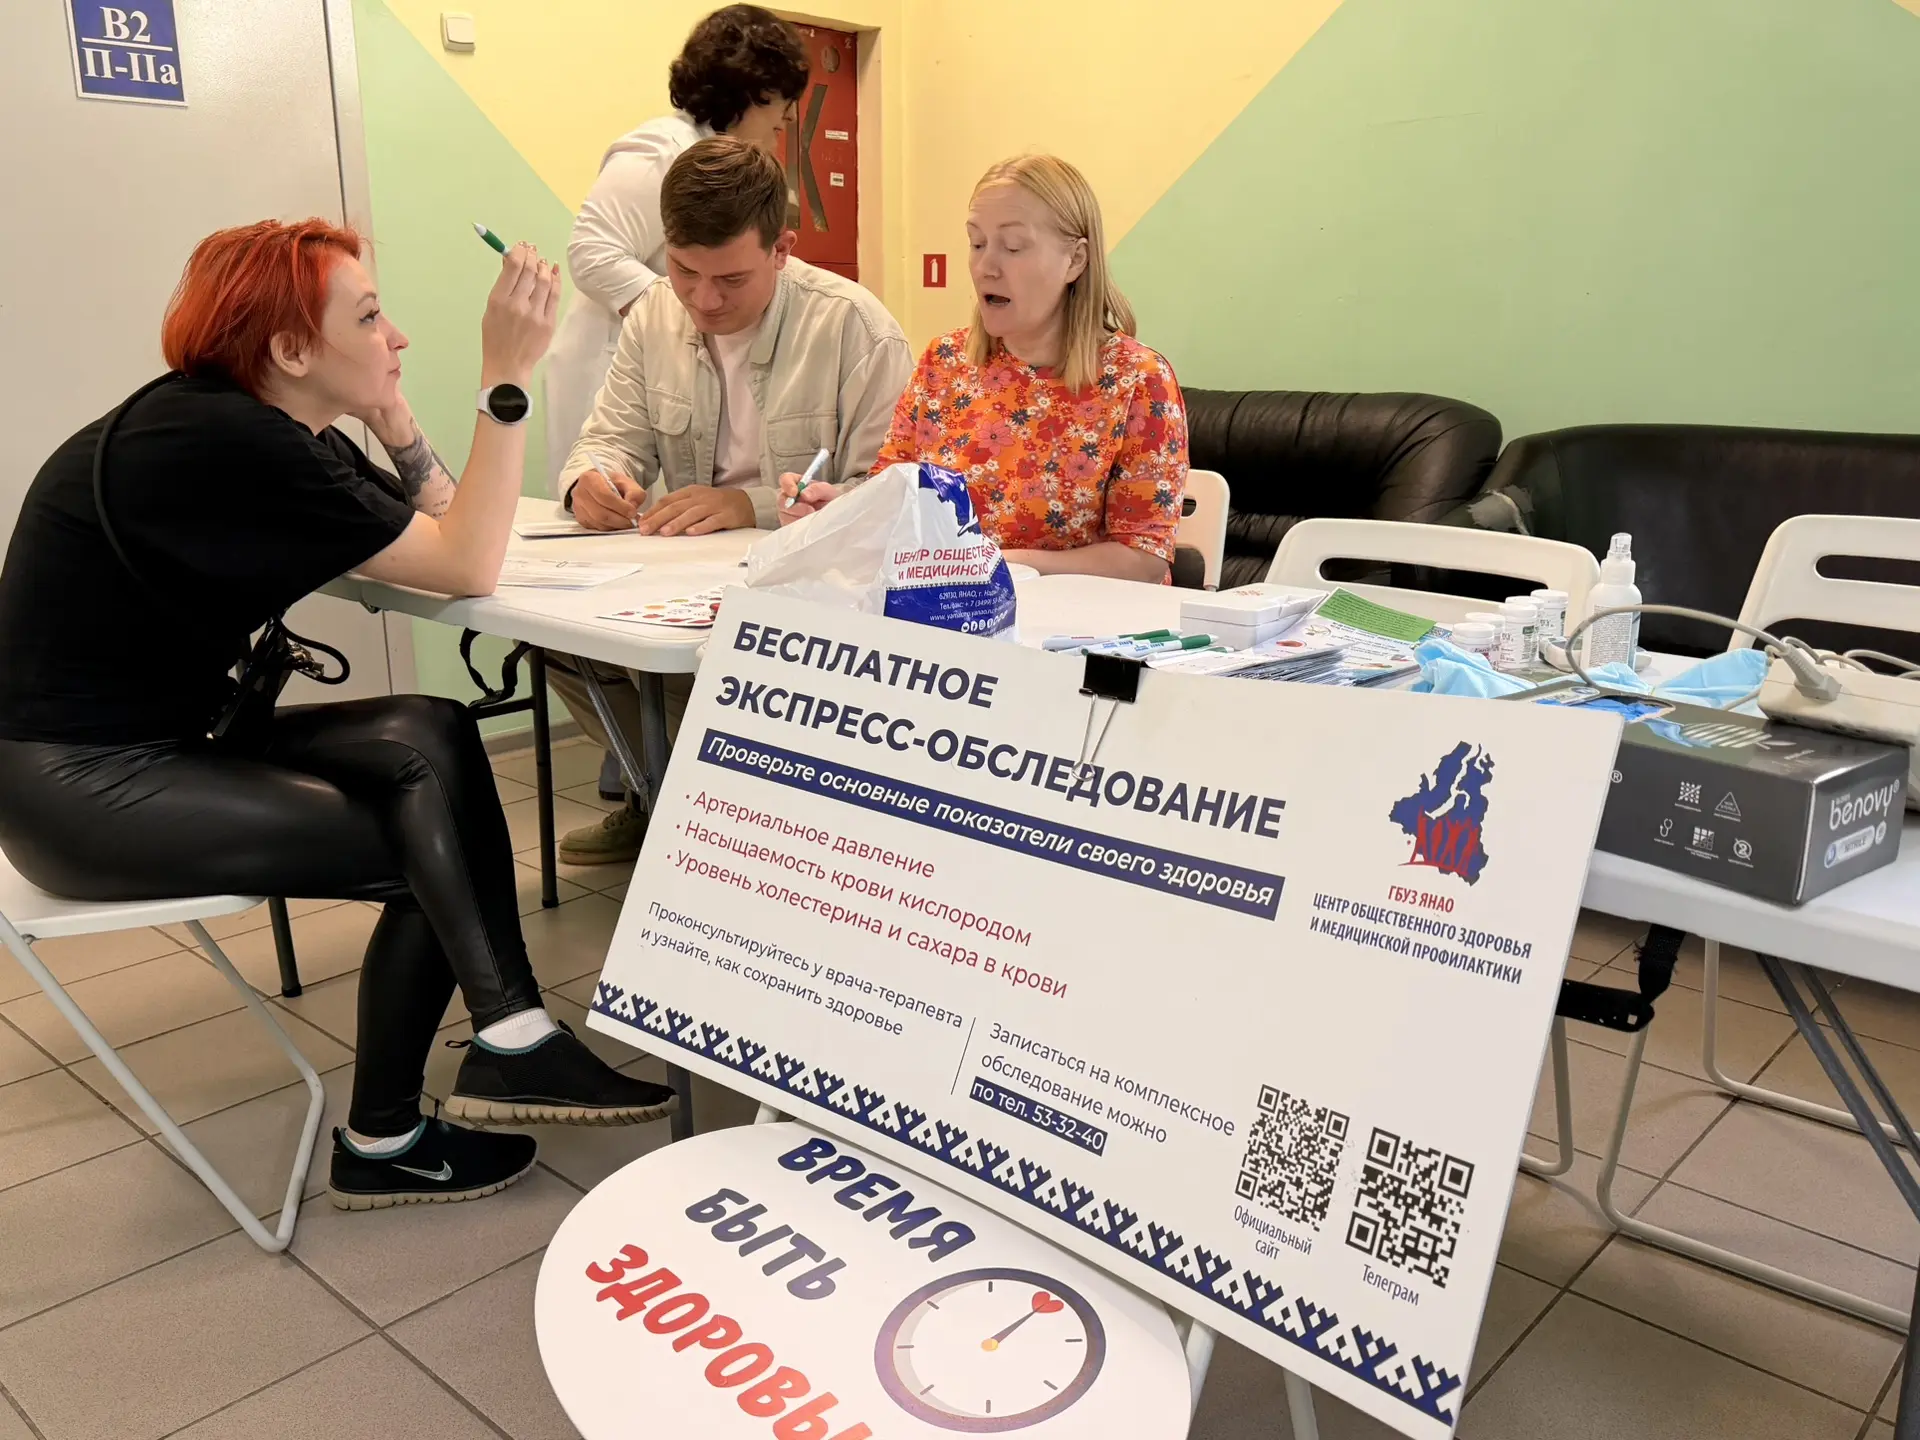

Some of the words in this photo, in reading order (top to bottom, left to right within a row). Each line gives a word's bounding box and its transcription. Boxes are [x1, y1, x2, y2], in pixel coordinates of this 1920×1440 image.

[893, 549, 930, 565] ЦЕНТР
[733, 621, 999, 709] БЕСПЛАТНОЕ
[715, 675, 1287, 839] ЭКСПРЕСС-ОБСЛЕДОВАНИЕ
[692, 791, 830, 846] Артериальное
[831, 836, 935, 878] давление
[707, 736, 816, 782] Проверьте
[819, 771, 930, 814] основные
[933, 802, 1074, 854] показатели
[1077, 842, 1156, 875] своего
[1158, 862, 1275, 906] здоровья
[675, 849, 752, 890] Уровень
[755, 880, 883, 935] холестерина
[887, 924, 902, 941] и
[906, 931, 979, 967] сахара
[983, 956, 997, 973] в
[1001, 962, 1067, 999] крови
[684, 819, 826, 880] Насыщаемость
[830, 869, 894, 902] крови
[898, 891, 1032, 947] кислородом
[1313, 893, 1350, 914] ЦЕНТР
[1350, 902, 1457, 940] ОБЩЕСТВЕННОГО
[1457, 927, 1532, 959] ЗДОРОВЬЯ
[1388, 885, 1418, 905] ГБУЗ
[1418, 892, 1455, 914] ЯНАО
[640, 928, 651, 941] и
[650, 932, 711, 966] узнайте,
[714, 955, 741, 975] как
[743, 966, 822, 1005] сохранить
[825, 996, 903, 1036] здоровье
[648, 901, 810, 971] Проконсультируйтесь
[810, 962, 824, 978] у
[825, 967, 963, 1028] врача-терапевта
[1309, 916, 1320, 931] И
[1319, 919, 1411, 956] МЕДИЦИНСКОЙ
[1411, 942, 1523, 985] ПРОФИЛАКТИКИ
[972, 1082, 994, 1101] по
[998, 1092, 1028, 1118] тел.
[1031, 1104, 1104, 1150] 53-32-40
[981, 1054, 1103, 1115] обследование
[1106, 1106, 1167, 1143] можно
[989, 1022, 1086, 1074] Записаться
[1089, 1064, 1110, 1085] на
[1113, 1074, 1235, 1136] комплексное
[777, 1137, 976, 1262] ВРЕМЯ
[1234, 1205, 1312, 1255] Официальный
[684, 1188, 847, 1300] БЫТЬ
[1255, 1239, 1281, 1260] сайт
[1362, 1263, 1419, 1306] Телеграм
